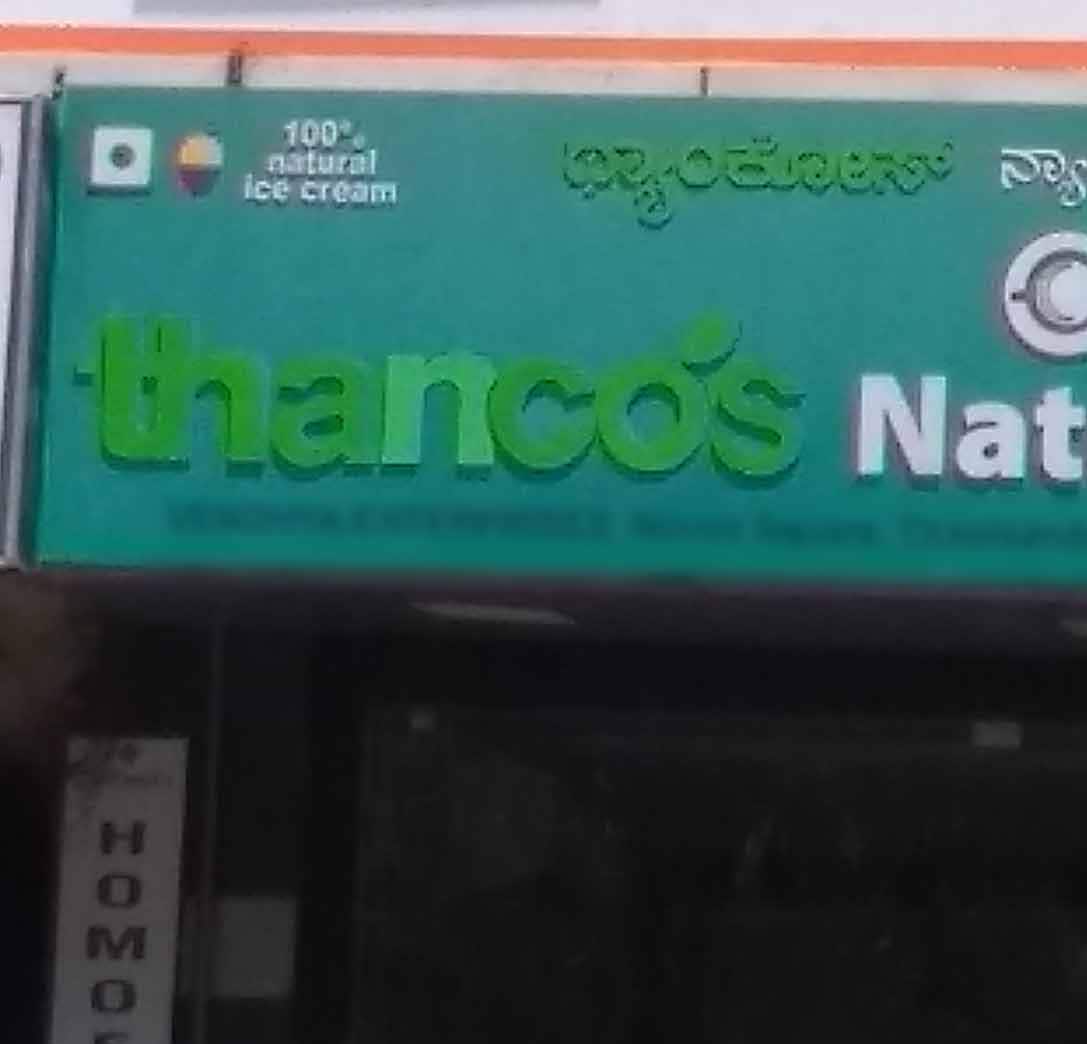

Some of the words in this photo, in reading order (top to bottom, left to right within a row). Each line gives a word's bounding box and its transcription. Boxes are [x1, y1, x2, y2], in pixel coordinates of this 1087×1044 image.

[284, 119, 365, 150] 100%
[268, 150, 375, 175] natural
[300, 180, 397, 204] cream
